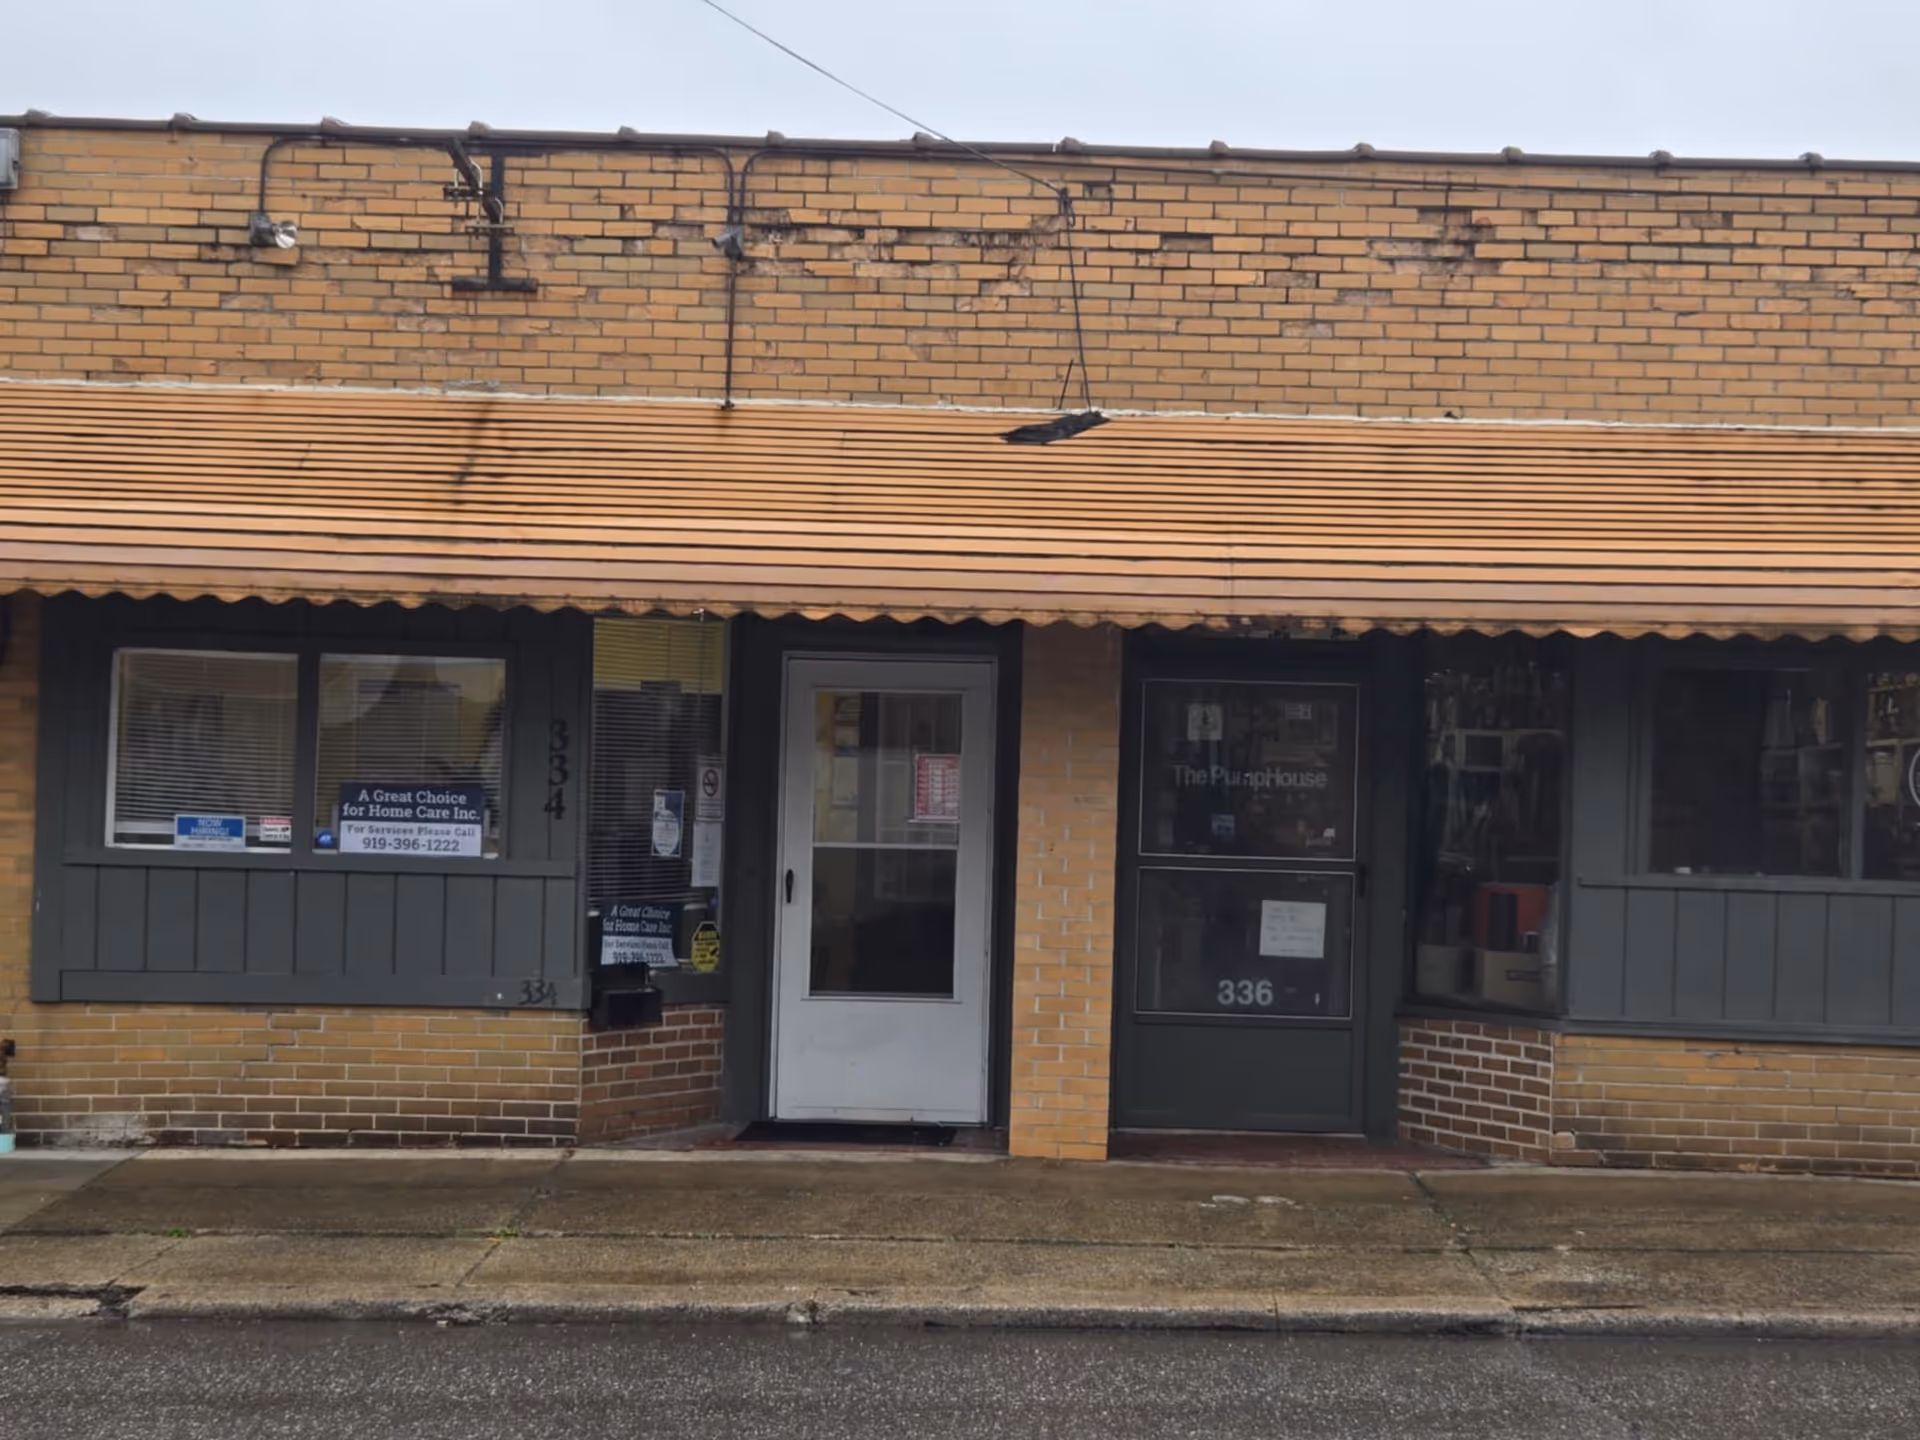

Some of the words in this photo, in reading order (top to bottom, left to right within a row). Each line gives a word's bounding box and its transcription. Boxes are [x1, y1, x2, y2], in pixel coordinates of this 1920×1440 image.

[544, 719, 569, 820] 334
[1172, 764, 1208, 786] The
[358, 789, 370, 802] A
[373, 789, 413, 803] Great
[416, 790, 467, 805] Choice
[342, 802, 365, 817] for
[368, 804, 413, 818] Home
[416, 805, 450, 819] Care
[453, 806, 480, 821] Inc.
[347, 824, 365, 834] For
[368, 824, 414, 835] Services
[417, 826, 451, 836] Please
[454, 827, 476, 837] Call
[362, 837, 460, 852] 919-396-1222
[610, 905, 619, 917] A
[518, 979, 558, 1006] 334
[1217, 979, 1273, 1006] 336
